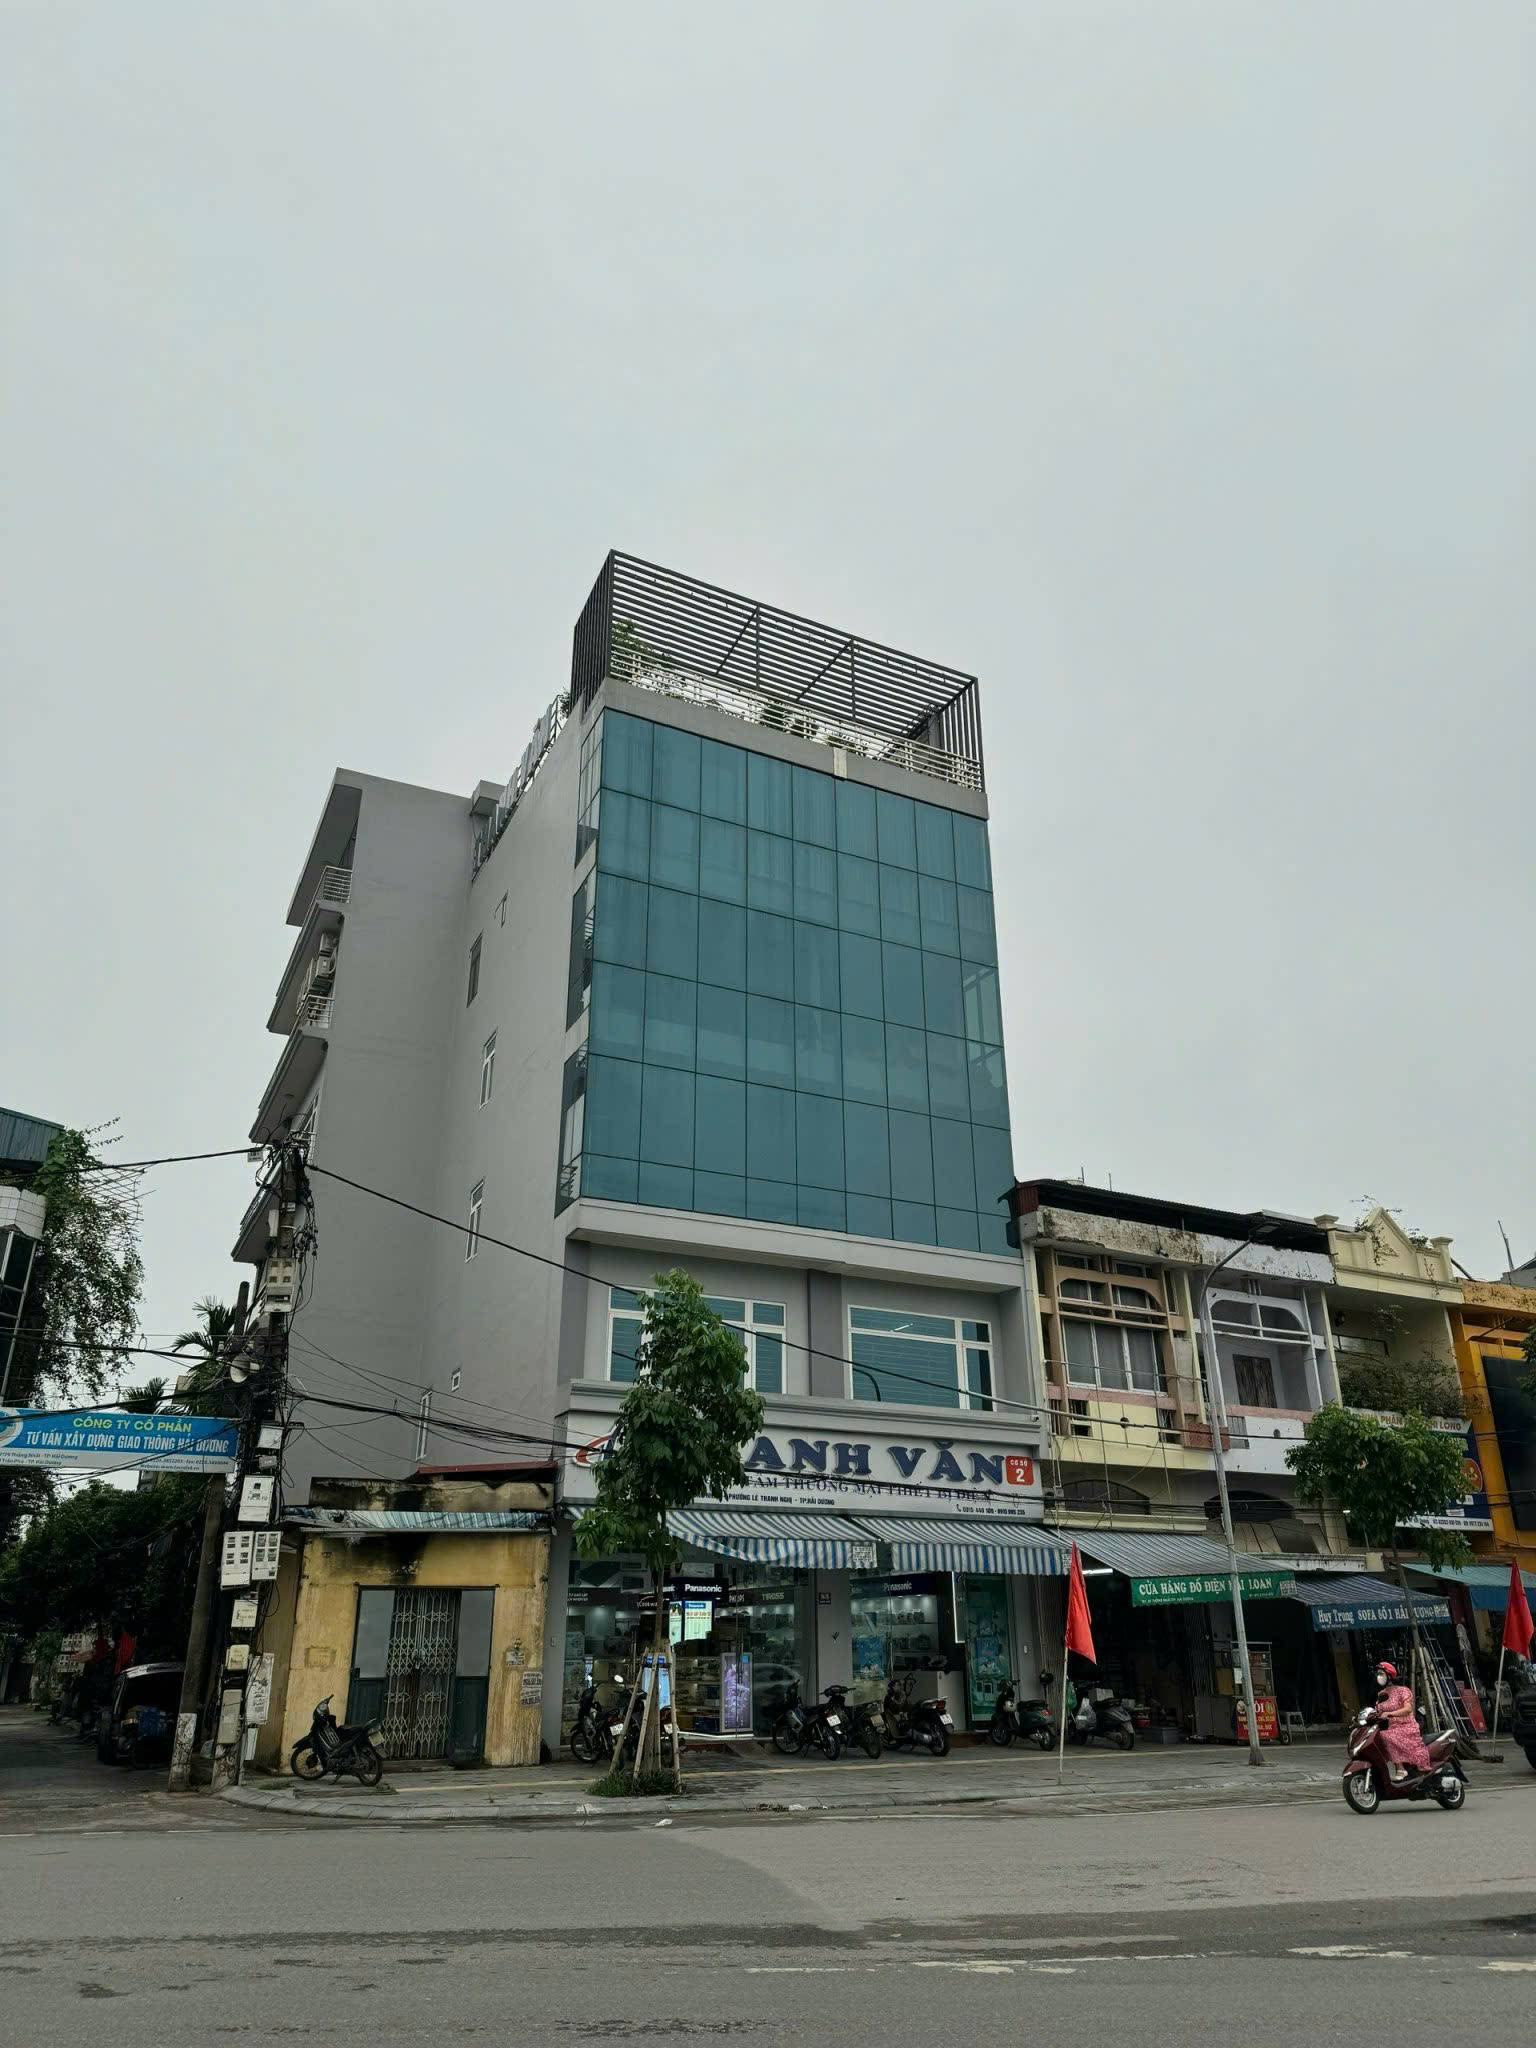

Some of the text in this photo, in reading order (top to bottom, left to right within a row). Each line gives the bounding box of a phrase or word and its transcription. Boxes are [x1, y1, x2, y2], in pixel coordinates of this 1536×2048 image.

[73, 1416, 112, 1429] CÔNG
[117, 1420, 131, 1430] TY
[1440, 1422, 1461, 1431] LONG
[27, 1430, 41, 1445] TƯ
[41, 1427, 62, 1446] VẤN
[64, 1431, 85, 1447] XÂY
[87, 1434, 115, 1451] DỰNG
[117, 1435, 141, 1449] GIAO
[143, 1434, 175, 1451] THÔNG
[745, 1435, 872, 1476] ANH
[1015, 1468, 1025, 1483] 2
[760, 1494, 779, 1503] THANH
[684, 1583, 723, 1593] Panasonic
[1138, 1580, 1157, 1596] CỬA
[1160, 1579, 1187, 1595] HÀNG
[1204, 1579, 1226, 1594] ĐIỆN
[1248, 1577, 1273, 1590] LOAN
[762, 1592, 785, 1601] TIROSS
[1317, 1609, 1332, 1625] Huy
[1332, 1609, 1355, 1625] Trung
[1357, 1608, 1378, 1621] SOFA
[1377, 1605, 1388, 1620] SỐ
[1388, 1608, 1394, 1620] 1
[1394, 1605, 1410, 1619] HẢI
[1413, 1606, 1434, 1618] ƯƠNG
